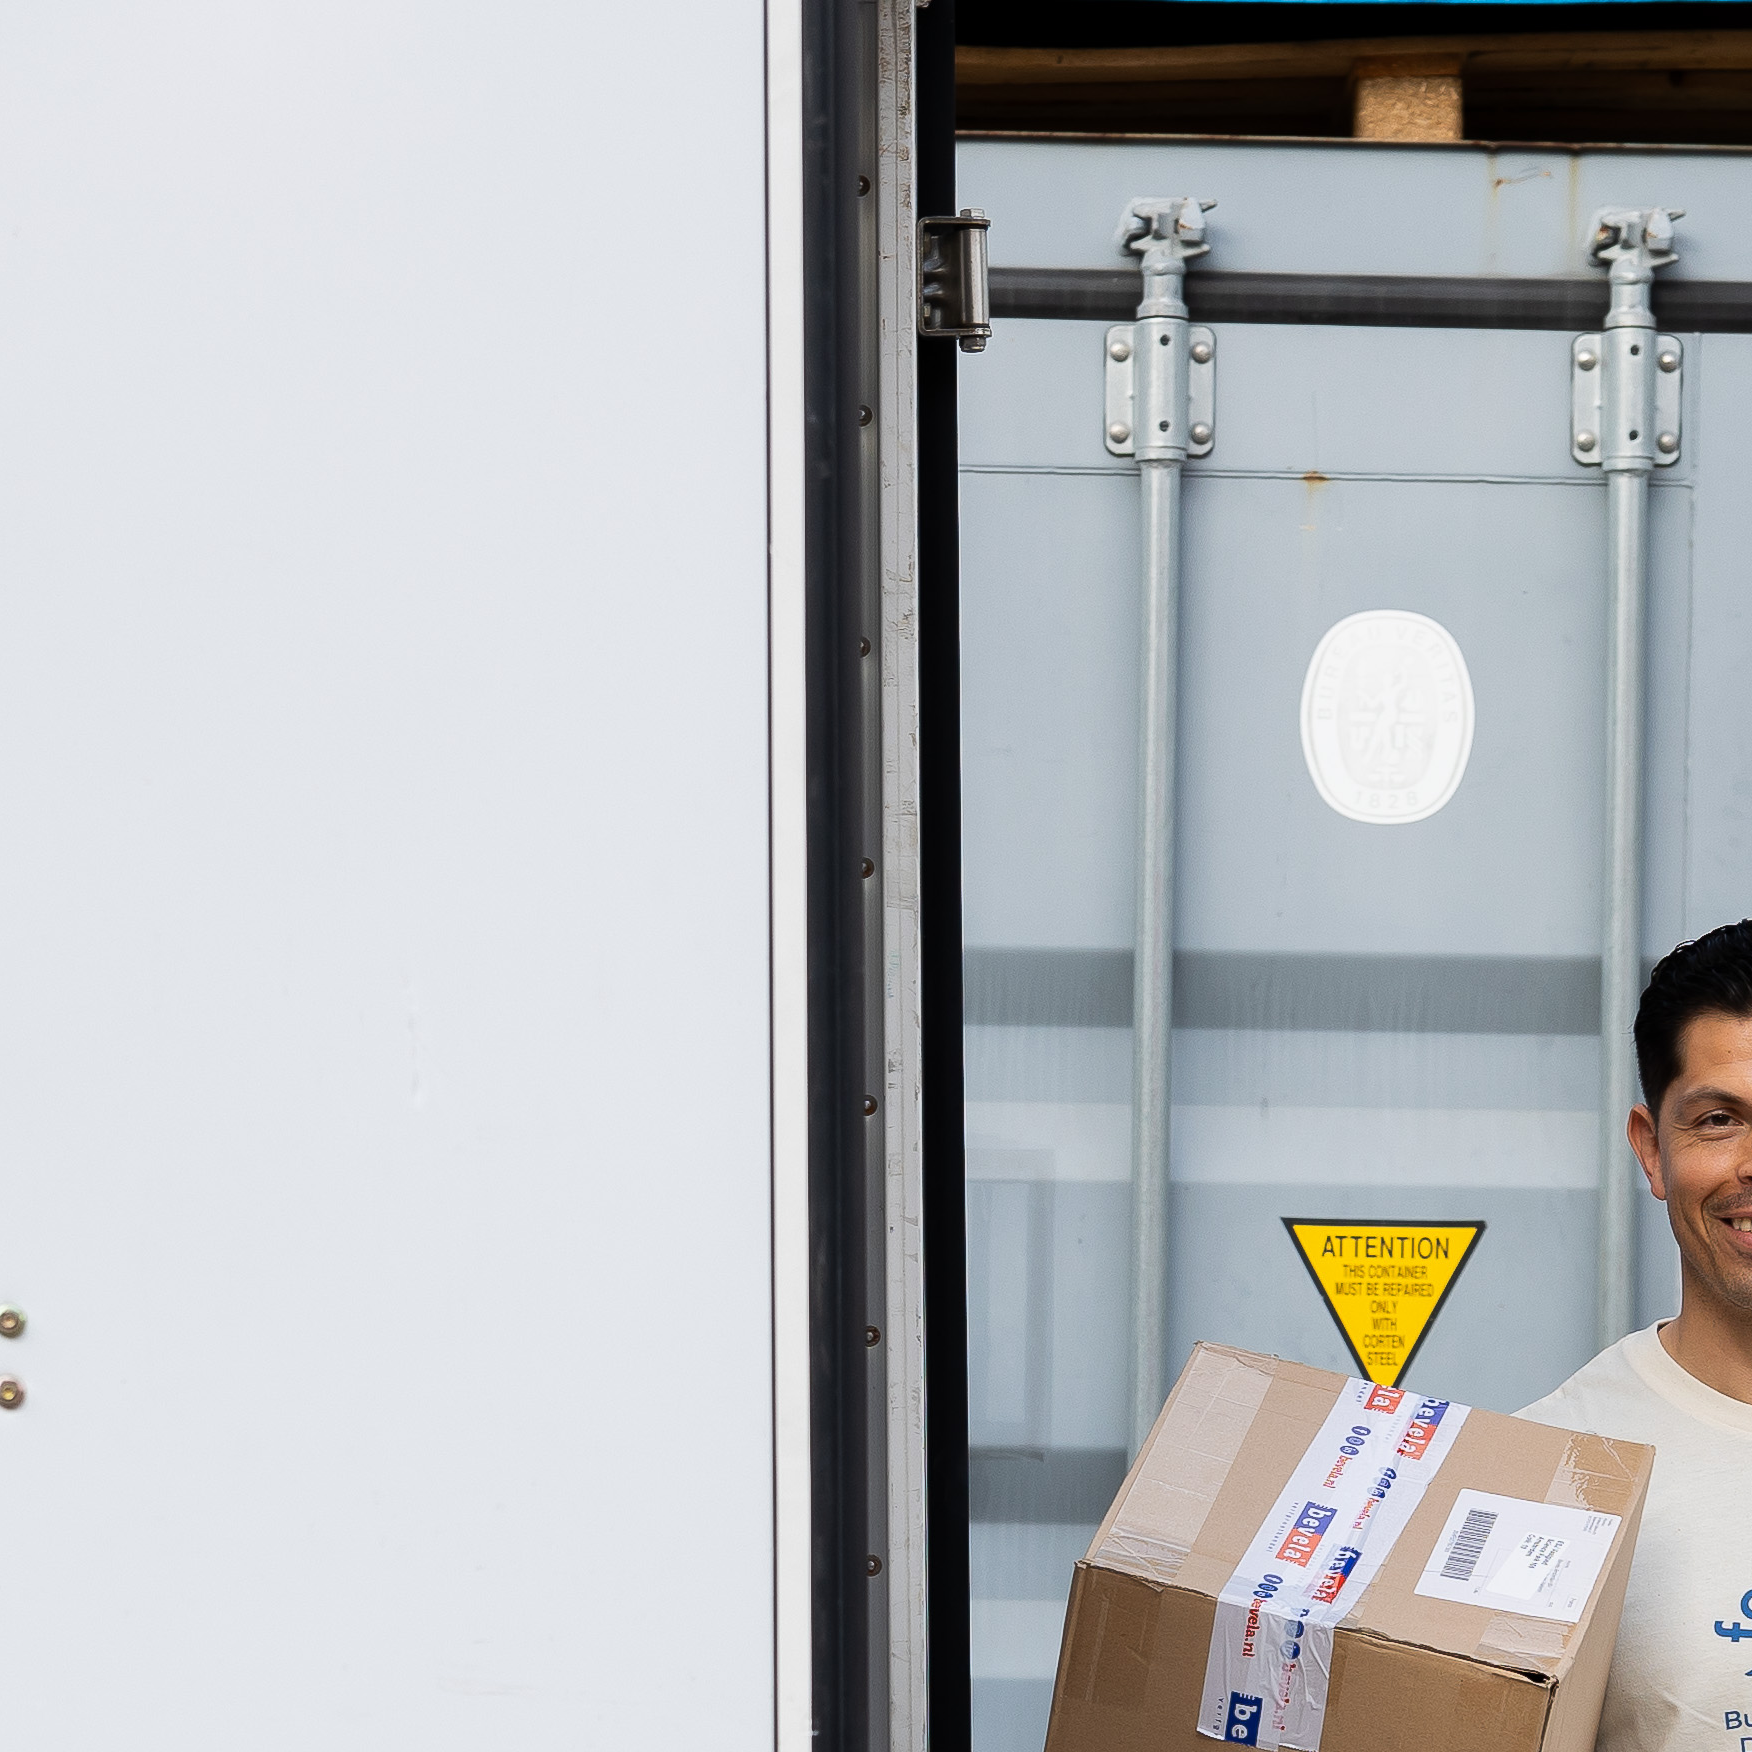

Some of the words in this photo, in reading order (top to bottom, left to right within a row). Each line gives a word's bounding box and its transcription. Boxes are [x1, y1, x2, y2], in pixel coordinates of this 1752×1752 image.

[1316, 625, 1382, 721] BUREAU
[1395, 625, 1460, 724] VERITAS
[1353, 790, 1419, 810] 1828
[1322, 1236, 1450, 1259] ATTENTION
[1343, 1265, 1366, 1279] THIS
[1368, 1265, 1428, 1280] CONTAINER
[1335, 1283, 1363, 1296] MUST
[1366, 1283, 1380, 1296] BE
[1383, 1284, 1434, 1298] REPAIRED
[1370, 1300, 1398, 1314] ONLY
[1372, 1318, 1397, 1331] WITH
[1363, 1335, 1405, 1349] CORTEN
[1367, 1352, 1398, 1366] STEEL
[1400, 1398, 1449, 1454] bevela
[1283, 1507, 1332, 1560] bevela
[1231, 1703, 1257, 1740] be
